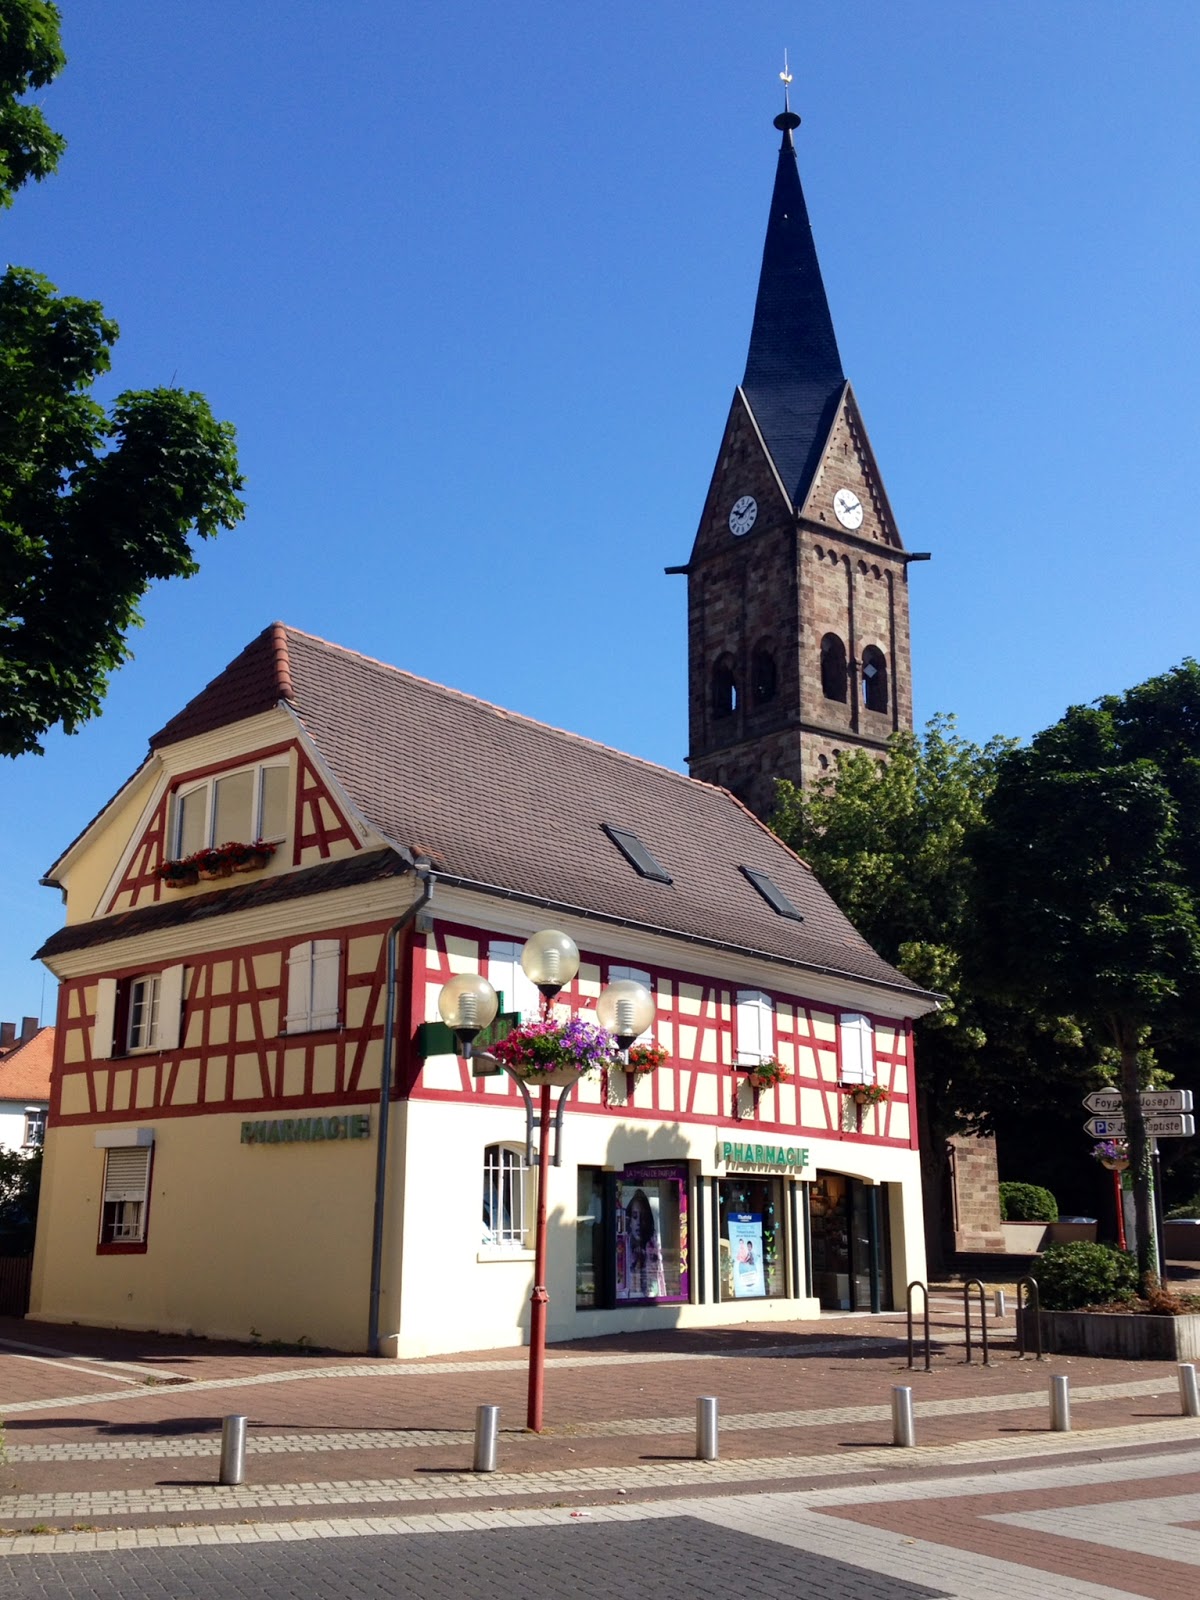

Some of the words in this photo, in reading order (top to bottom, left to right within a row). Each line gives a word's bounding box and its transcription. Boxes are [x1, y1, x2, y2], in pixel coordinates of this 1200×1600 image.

[1140, 1095, 1175, 1108] Joseph
[240, 1114, 369, 1144] PHARMACIE
[723, 1142, 809, 1166] PHARMACIE
